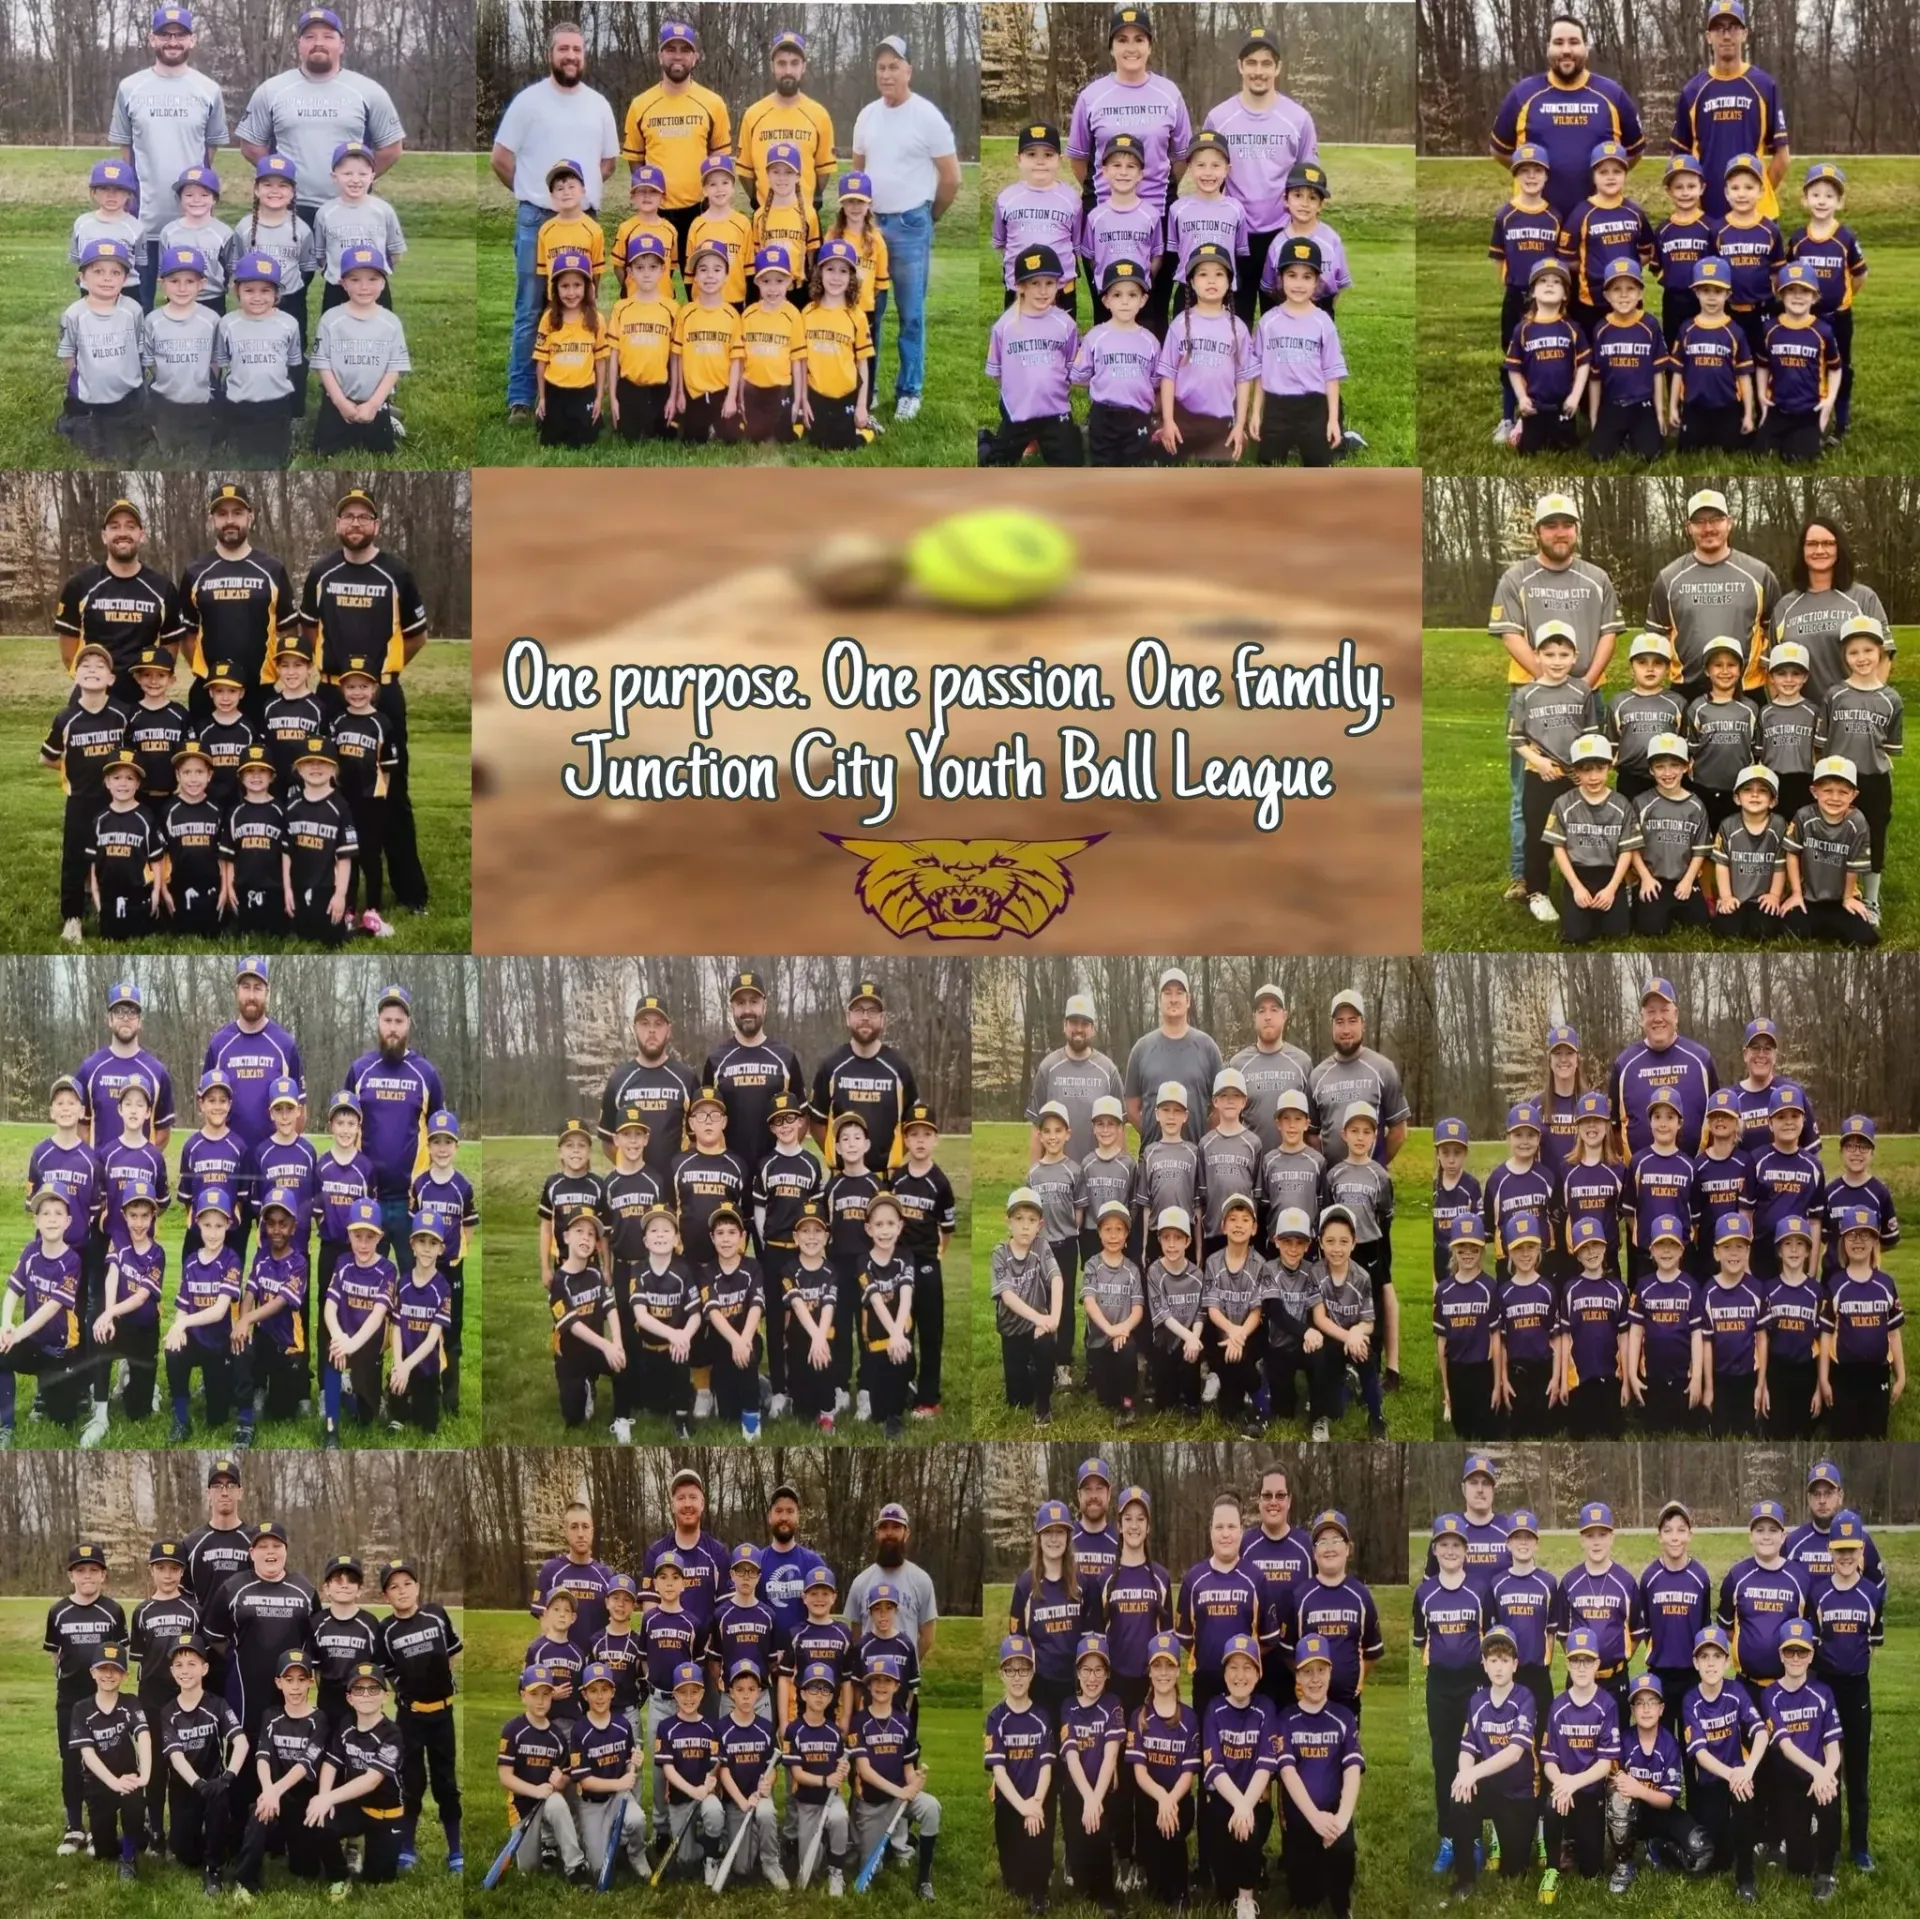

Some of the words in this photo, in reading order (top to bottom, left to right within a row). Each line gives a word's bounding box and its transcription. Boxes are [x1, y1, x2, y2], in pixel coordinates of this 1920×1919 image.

[1540, 104, 1580, 114] JUNCTION
[1582, 104, 1599, 114] CITY
[1704, 99, 1736, 111] JUNCTION
[1736, 97, 1752, 108] CITY
[1101, 106, 1147, 116] JUNCTION
[1148, 106, 1168, 115] CITY
[1714, 110, 1742, 121] WILDCATS
[647, 116, 683, 128] JUNCTION
[685, 115, 703, 125] CITY
[1553, 115, 1587, 125] WILDCATS
[759, 130, 793, 141] JUNCTION
[794, 130, 812, 141] CITY
[1227, 135, 1267, 145] JUNCTION
[1269, 135, 1290, 145] CITY
[201, 578, 242, 591] JUNCTION
[244, 579, 264, 590] CITY
[1679, 583, 1722, 594] JUNCTION
[1724, 583, 1746, 593] CITY
[213, 589, 250, 600] WILDCATS
[327, 584, 365, 595] JUNCTION
[367, 585, 387, 597] CITY
[1528, 588, 1568, 599] JUNCTION
[1570, 589, 1591, 599] CITY
[92, 599, 132, 610] JUNCTION
[134, 601, 155, 612] CITY
[336, 595, 372, 607] WILDCATS
[105, 611, 142, 622] WILDCATS
[1786, 613, 1828, 627] JUNCTION
[1830, 609, 1853, 620] CITY
[227, 1057, 258, 1068] JUNCTION
[259, 1057, 274, 1067] CITY
[236, 1068, 264, 1078] WILDCATS
[724, 1065, 757, 1077] JUNCTION
[759, 1064, 778, 1075] CITY
[1638, 1067, 1671, 1079] JUNCTION
[1672, 1065, 1688, 1077] CITY
[367, 1079, 397, 1090] JUNCTION
[399, 1079, 417, 1090] CITY
[734, 1075, 766, 1086] WILDCATS
[839, 1077, 873, 1090] JUNCTION
[873, 1079, 892, 1091] CITY
[1649, 1075, 1679, 1086] WILDCATS
[375, 1089, 405, 1100] WILDCATS
[625, 1089, 659, 1101] JUNCTION
[660, 1089, 679, 1100] CITY
[848, 1090, 881, 1101] WILDCATS
[1110, 1589, 1142, 1600] JUNCTION
[1142, 1589, 1157, 1600] CITY
[1198, 1591, 1230, 1604] JUNCTION
[1231, 1590, 1248, 1603] CITY
[1119, 1601, 1148, 1613] WILDCATS
[1207, 1603, 1238, 1615] WILDCATS
[1307, 1610, 1340, 1623] JUNCTION
[1341, 1609, 1358, 1622] CITY
[1318, 1624, 1348, 1635] WILDCATS
